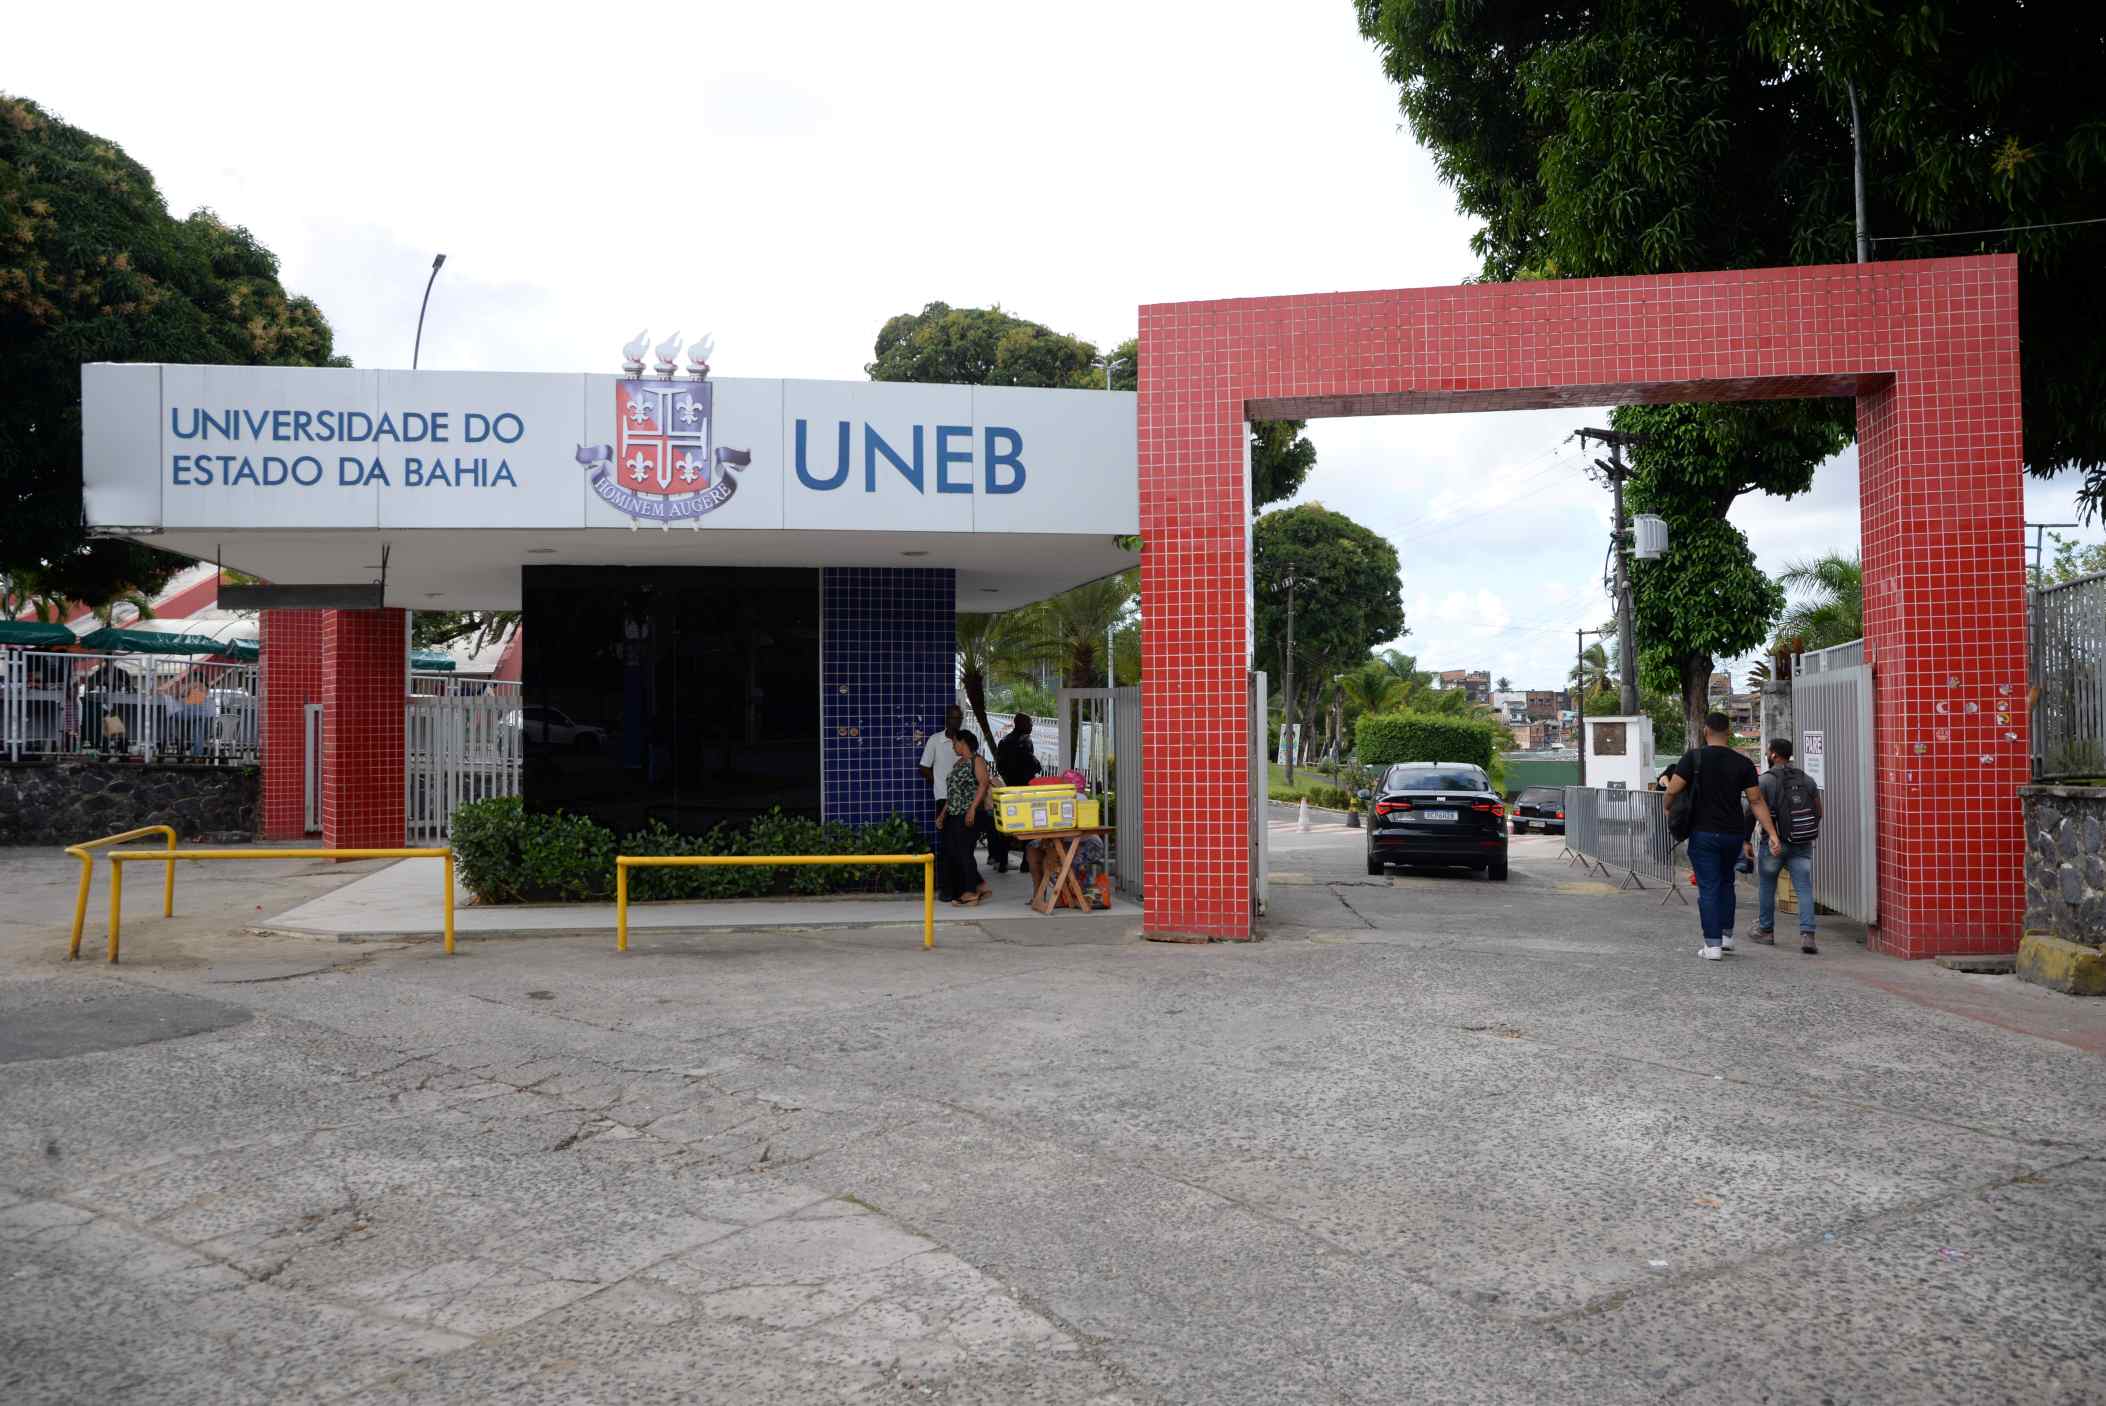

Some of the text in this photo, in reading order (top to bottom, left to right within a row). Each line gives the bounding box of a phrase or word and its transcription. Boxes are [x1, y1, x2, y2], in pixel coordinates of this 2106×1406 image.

[171, 407, 525, 444] UNIVERSIDADE DO
[171, 453, 518, 487] ESTADO DA BAHIA
[793, 416, 1027, 496] UNEB
[594, 477, 732, 517] HOMINEM AUGERE
